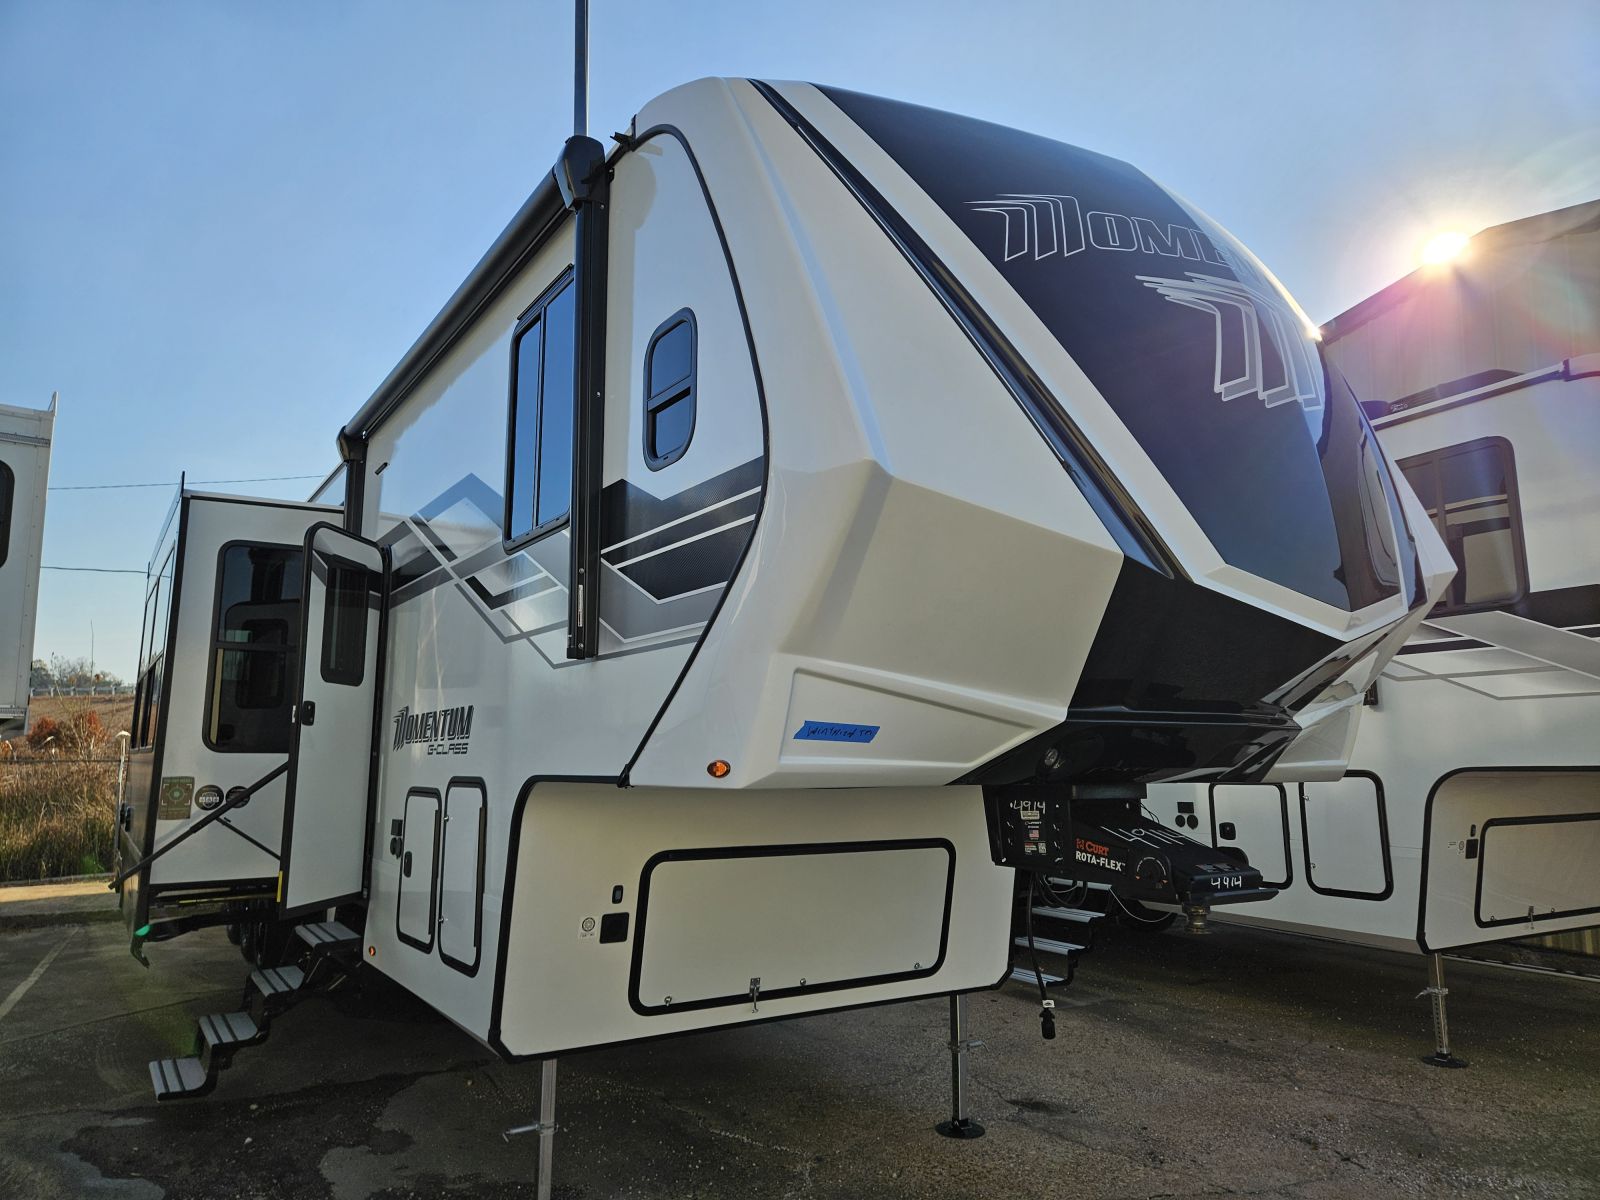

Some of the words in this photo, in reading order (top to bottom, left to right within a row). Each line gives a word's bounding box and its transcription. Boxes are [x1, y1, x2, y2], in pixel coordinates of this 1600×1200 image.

[393, 705, 474, 752] MOMENTUM
[427, 742, 469, 755] G-CLASS
[1013, 800, 1046, 815] 4914
[1085, 840, 1110, 856] CURT
[1211, 875, 1242, 889] 4914
